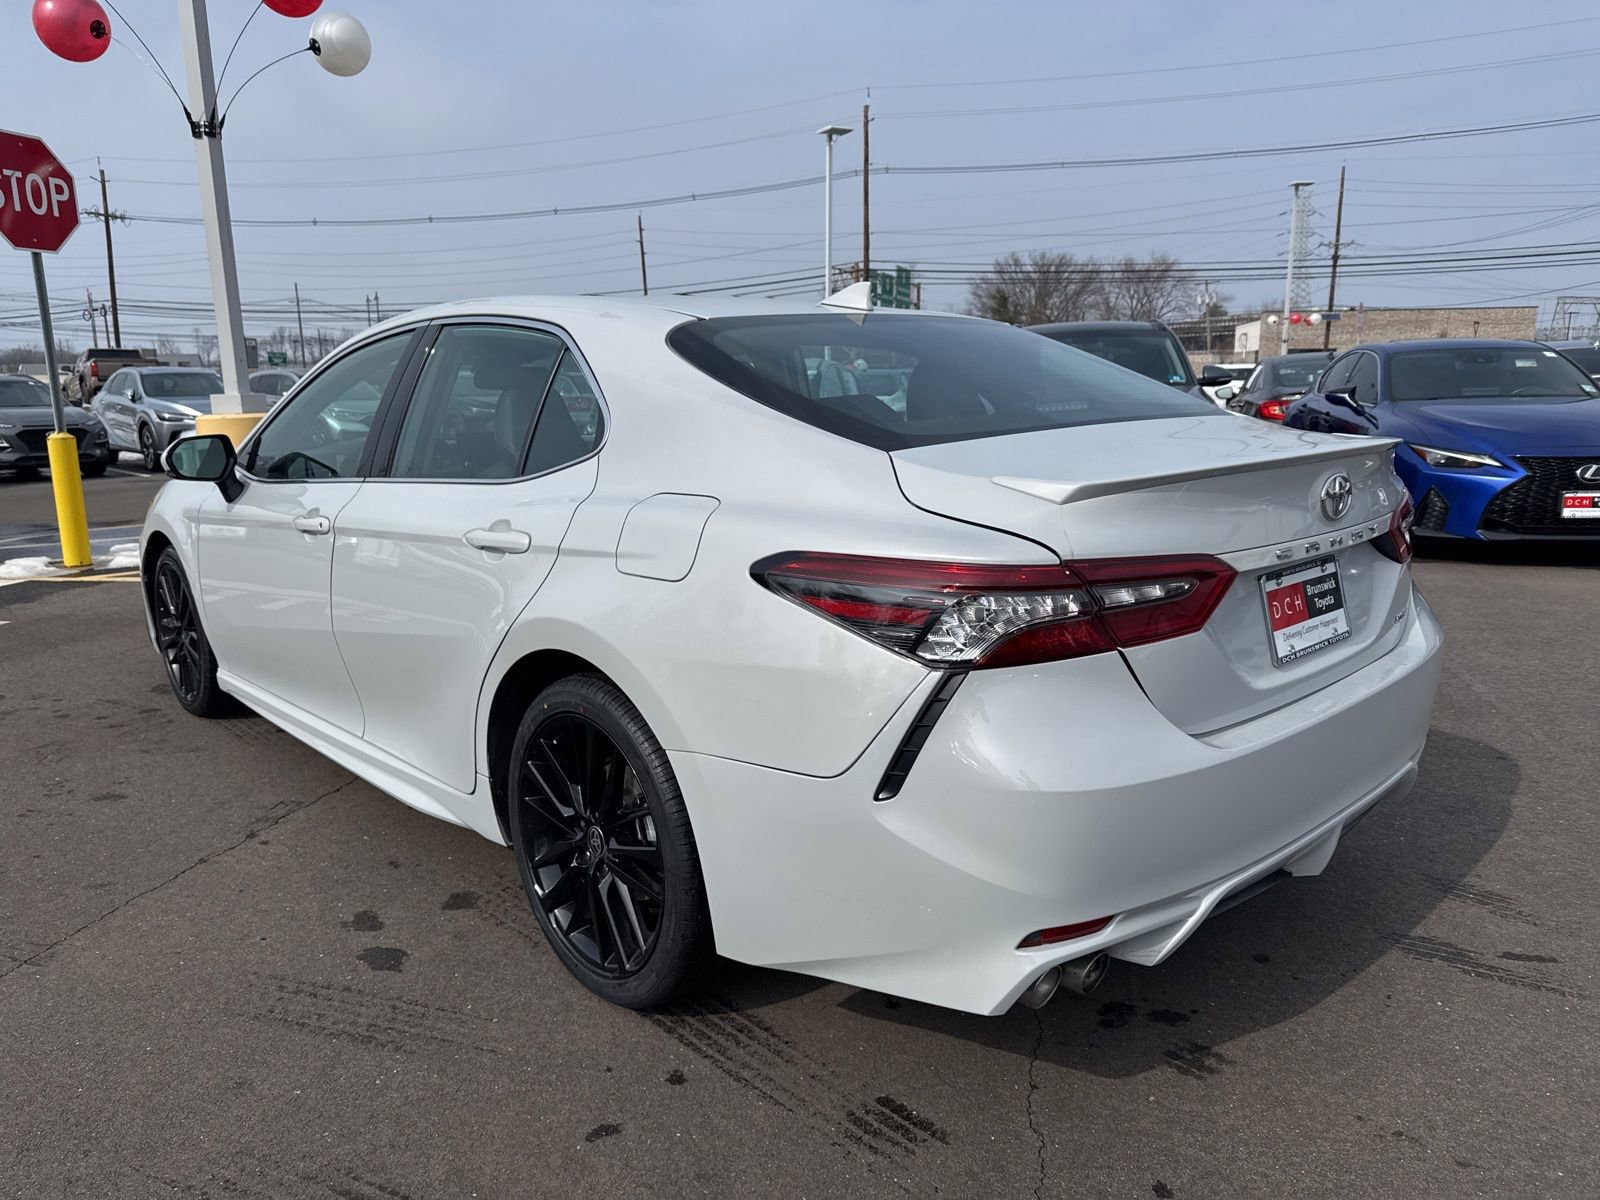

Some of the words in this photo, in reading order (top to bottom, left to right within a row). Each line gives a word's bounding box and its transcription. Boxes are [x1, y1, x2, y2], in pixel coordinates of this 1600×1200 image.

[1306, 577, 1336, 596] Brunswick
[1272, 594, 1303, 619] DCH
[1314, 595, 1335, 610] Toyota
[1282, 653, 1296, 663] DCH
[1296, 641, 1329, 658] BRUNSWICK
[1329, 632, 1350, 645] TOYOTA
